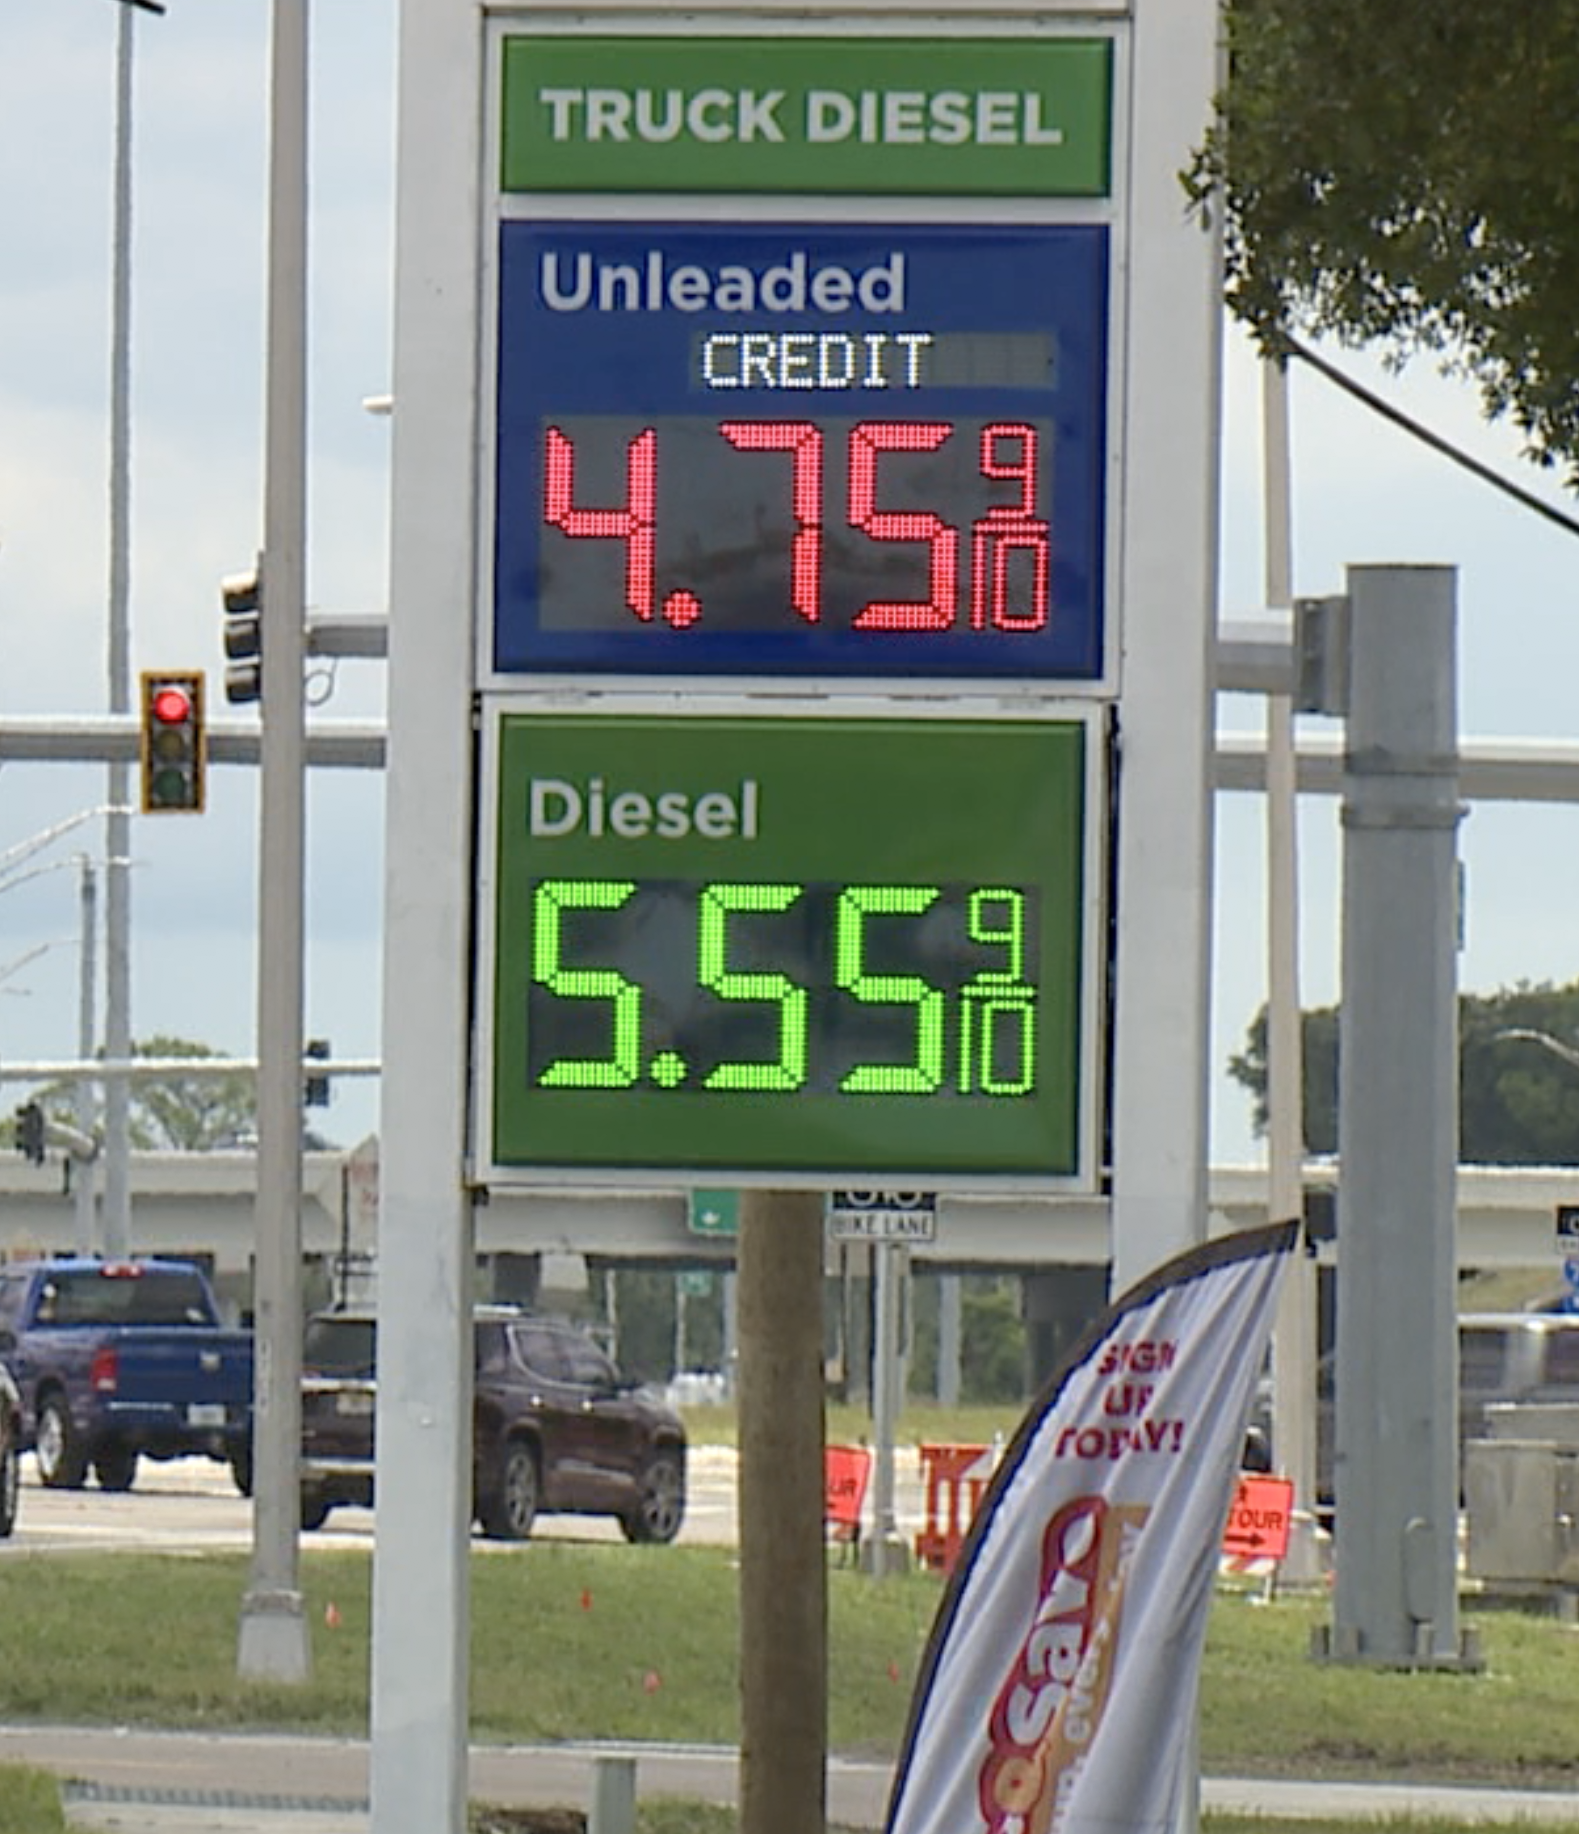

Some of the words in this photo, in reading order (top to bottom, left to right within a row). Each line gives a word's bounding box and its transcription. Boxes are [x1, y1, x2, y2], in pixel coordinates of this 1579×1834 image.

[540, 90, 784, 141] TRUCK
[807, 92, 1062, 144] DIESEL
[541, 251, 905, 312] Unleaded
[703, 334, 932, 388] CREDIT
[544, 423, 958, 630] 4.75
[529, 779, 758, 838] Diesel
[532, 880, 945, 1093] 5.55
[884, 1213, 930, 1235] LANE
